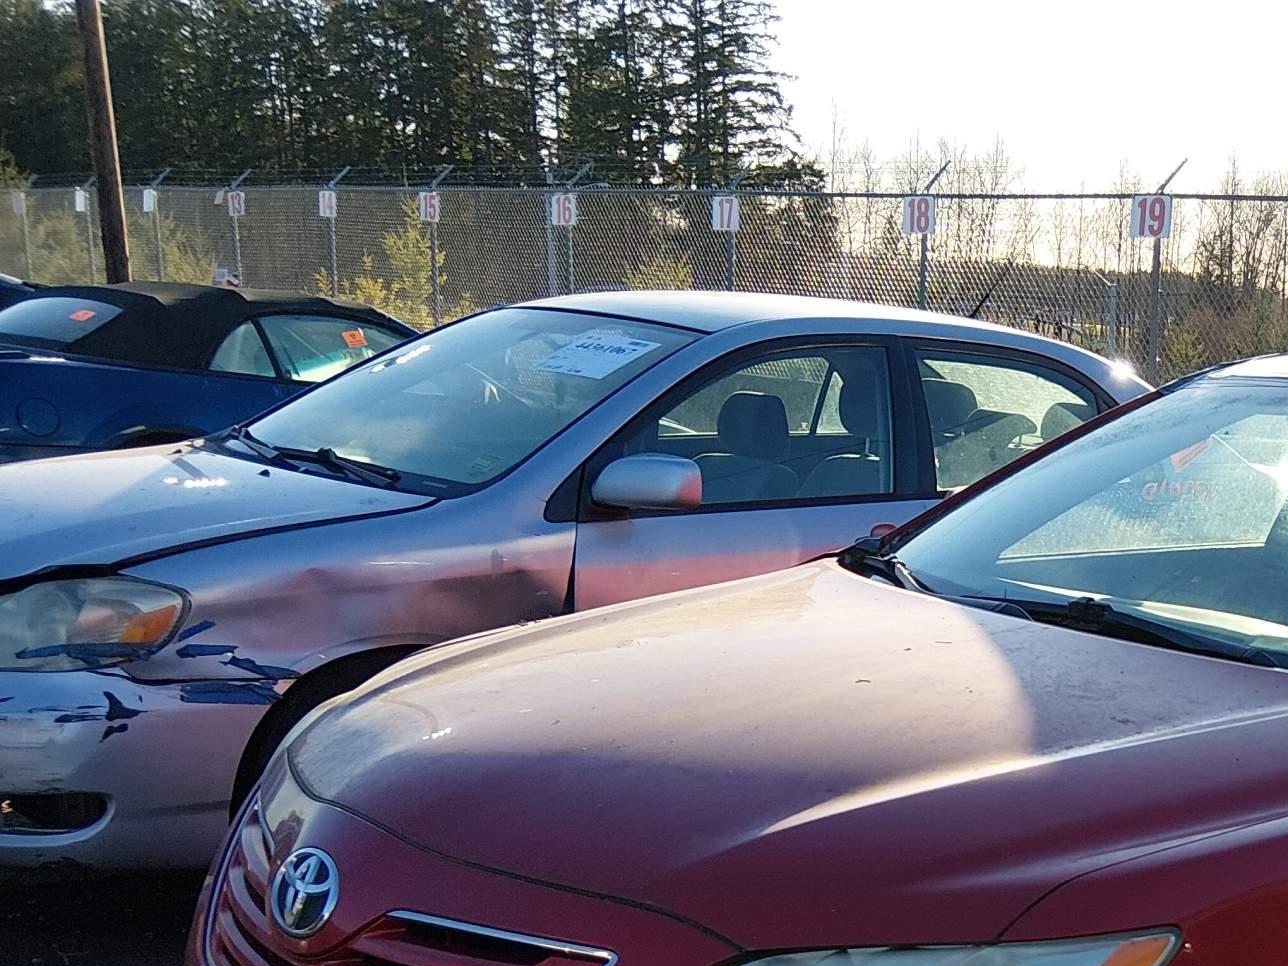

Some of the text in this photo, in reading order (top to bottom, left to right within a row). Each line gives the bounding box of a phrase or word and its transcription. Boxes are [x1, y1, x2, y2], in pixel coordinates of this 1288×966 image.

[424, 194, 437, 220] 15
[556, 195, 573, 225] 16
[718, 198, 734, 229] 17
[908, 197, 930, 233] 18
[1138, 197, 1166, 237] 19
